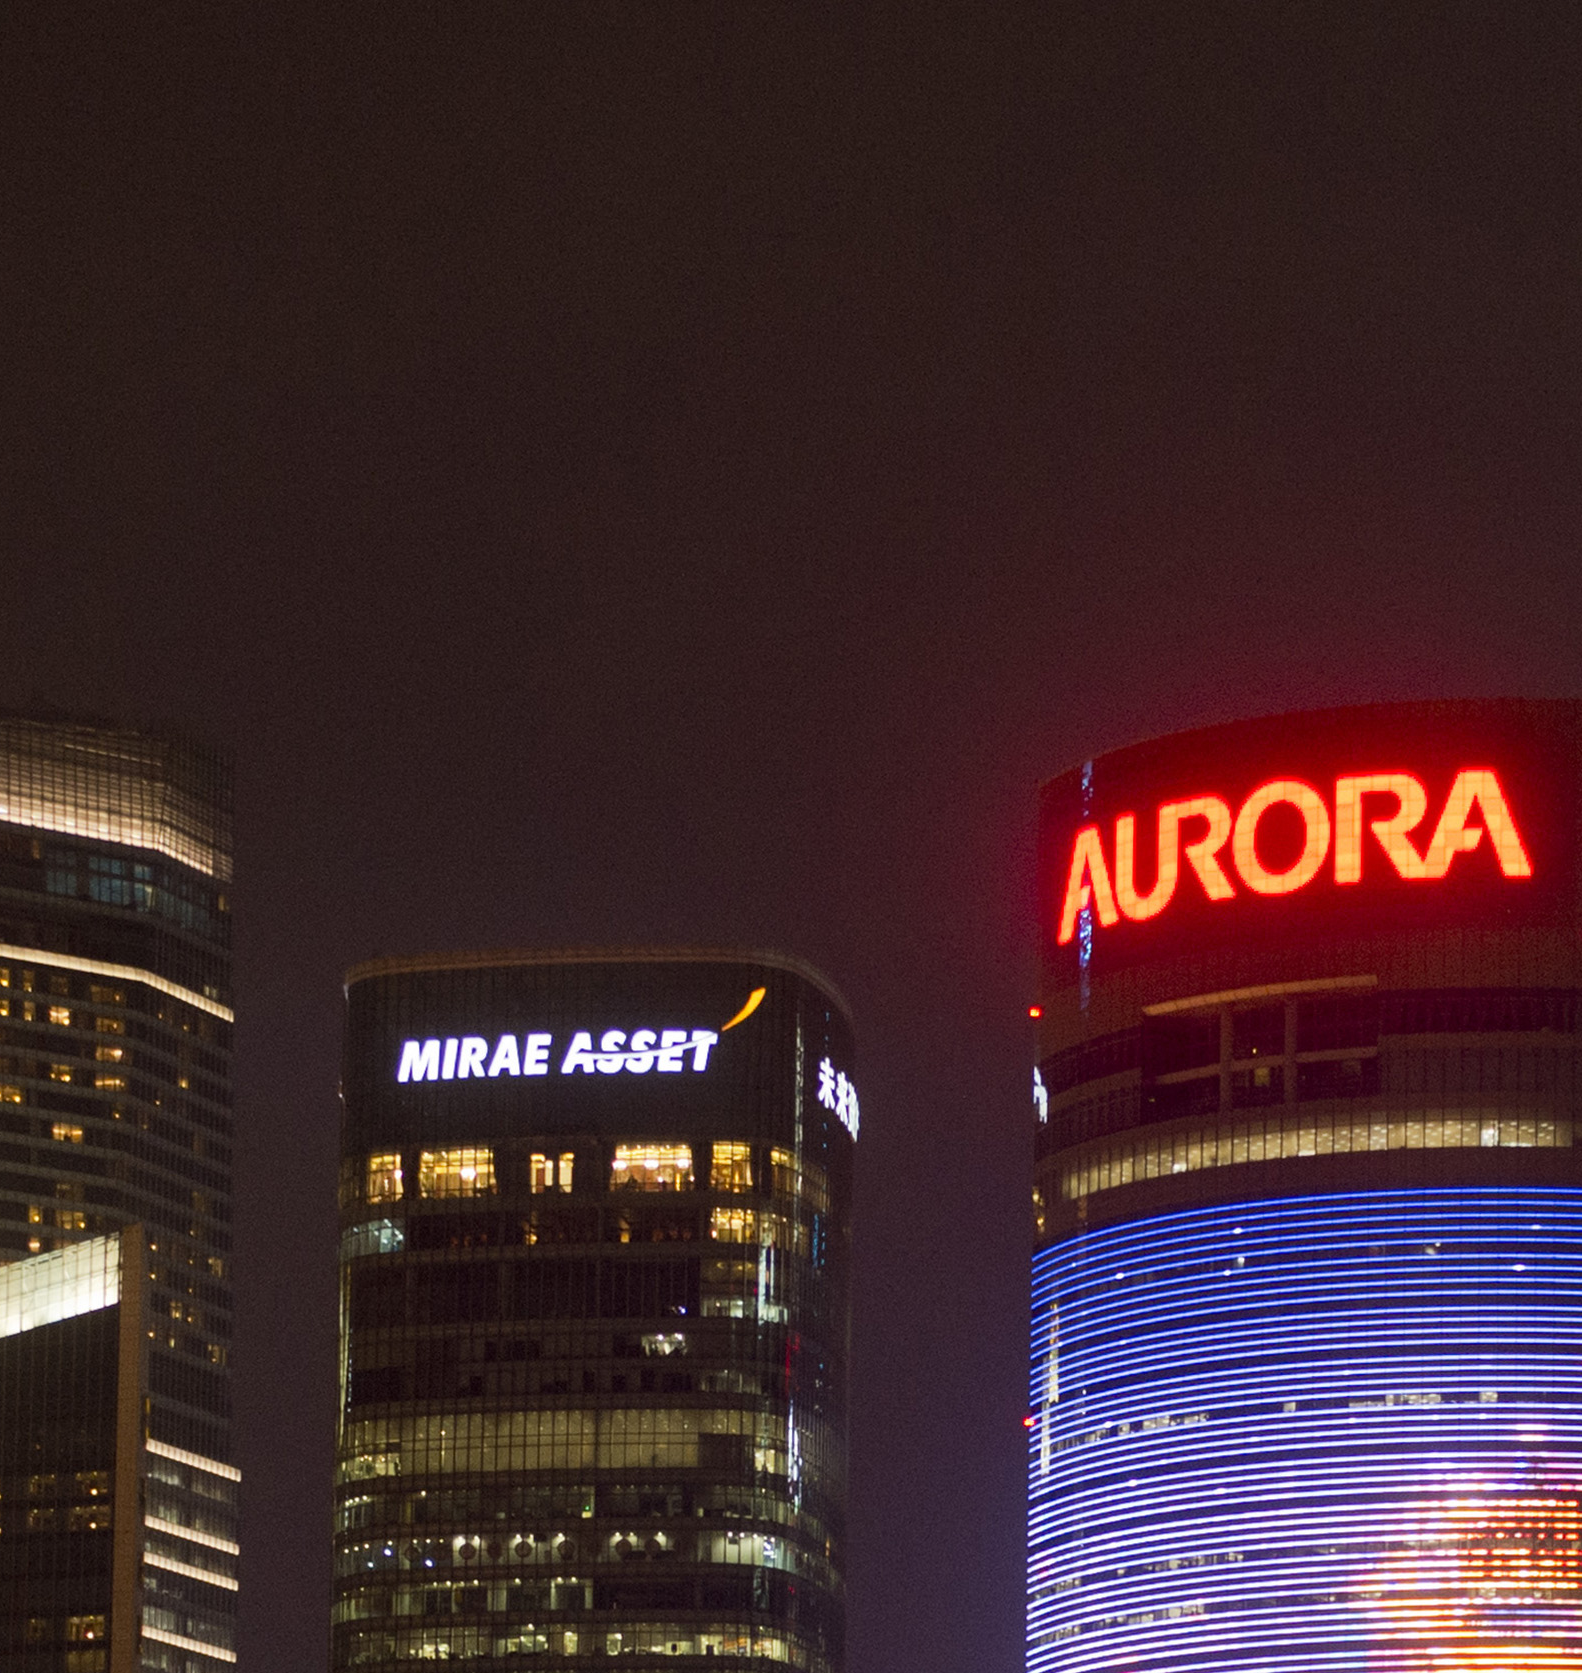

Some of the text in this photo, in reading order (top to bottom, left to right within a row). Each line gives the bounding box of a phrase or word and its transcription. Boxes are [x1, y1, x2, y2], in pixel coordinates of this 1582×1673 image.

[1058, 766, 1535, 947] AURORA
[396, 1029, 718, 1083] MIRAE ASSET
